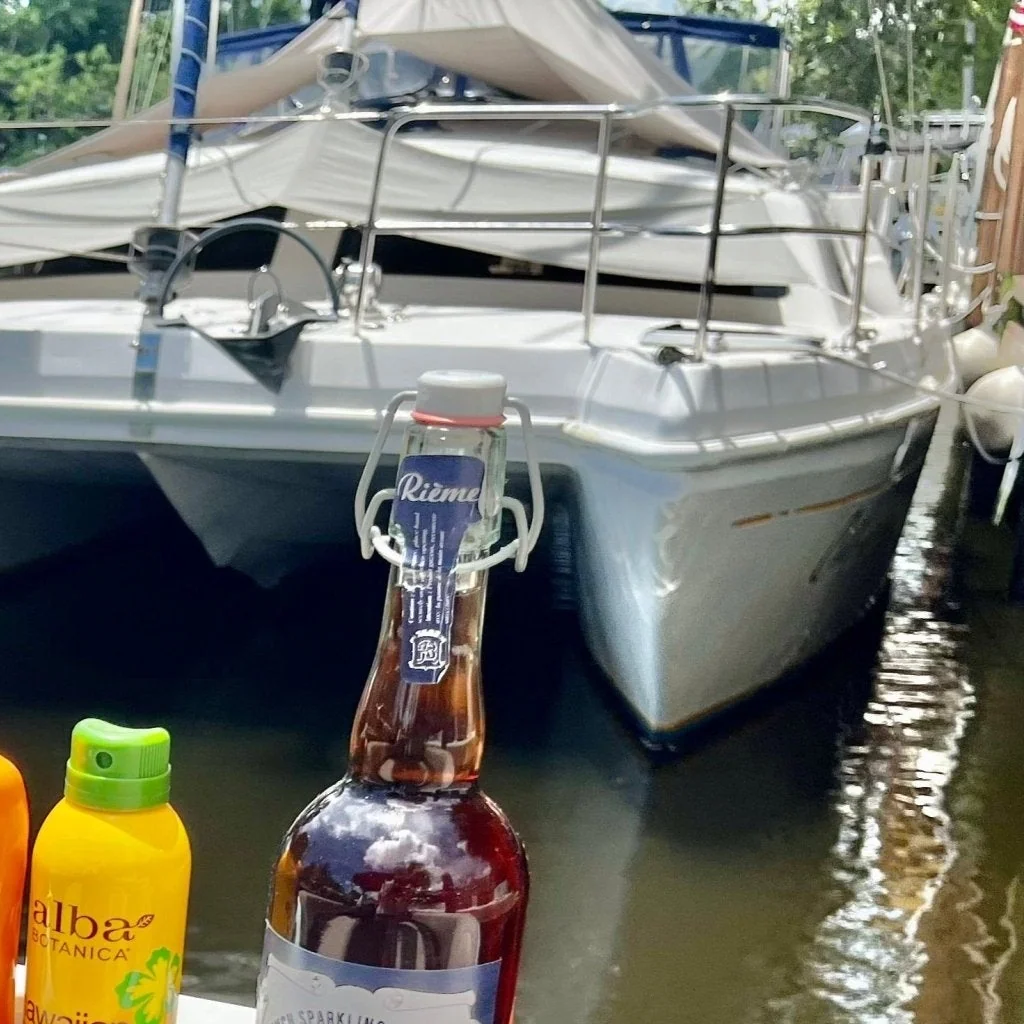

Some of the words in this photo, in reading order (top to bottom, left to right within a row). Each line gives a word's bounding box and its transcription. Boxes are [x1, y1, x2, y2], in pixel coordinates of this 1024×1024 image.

[397, 473, 481, 502] Rième
[33, 899, 136, 942] alba
[32, 929, 128, 961] BOTANICA
